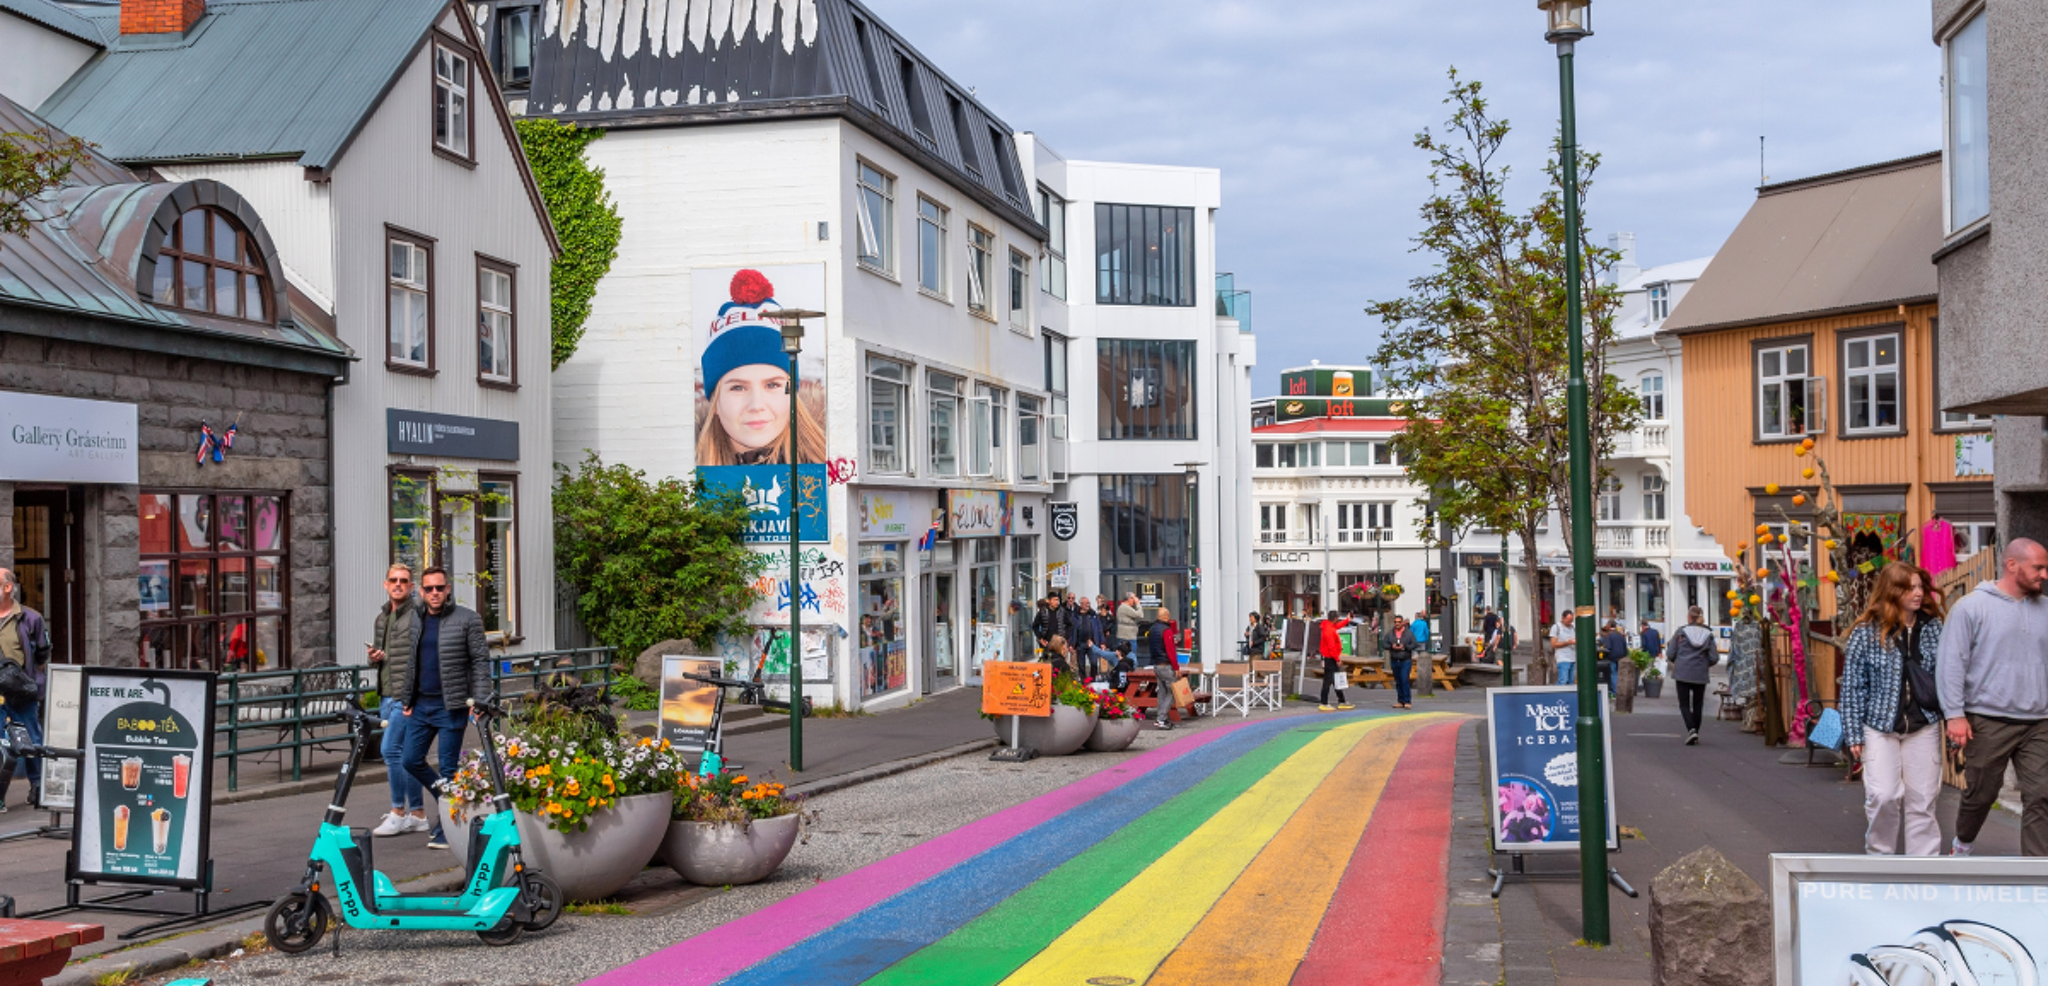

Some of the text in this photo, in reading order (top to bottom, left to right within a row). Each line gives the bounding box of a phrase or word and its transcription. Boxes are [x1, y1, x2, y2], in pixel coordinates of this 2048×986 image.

[1289, 377, 1307, 395] loft
[1326, 399, 1355, 416] loft
[12, 424, 127, 451] Gallery Grásteinn
[68, 450, 125, 461] ART GALLERY
[1683, 561, 1718, 571] CORNER
[90, 687, 144, 698] HERE WE ARE
[1525, 703, 1570, 718] Magic
[1535, 714, 1572, 731] ICE
[125, 735, 168, 745] Bubble Tea
[1517, 734, 1576, 746] ICEBA
[339, 880, 359, 917] hopp
[1803, 883, 1873, 899] PURE
[1884, 884, 1938, 901] AND
